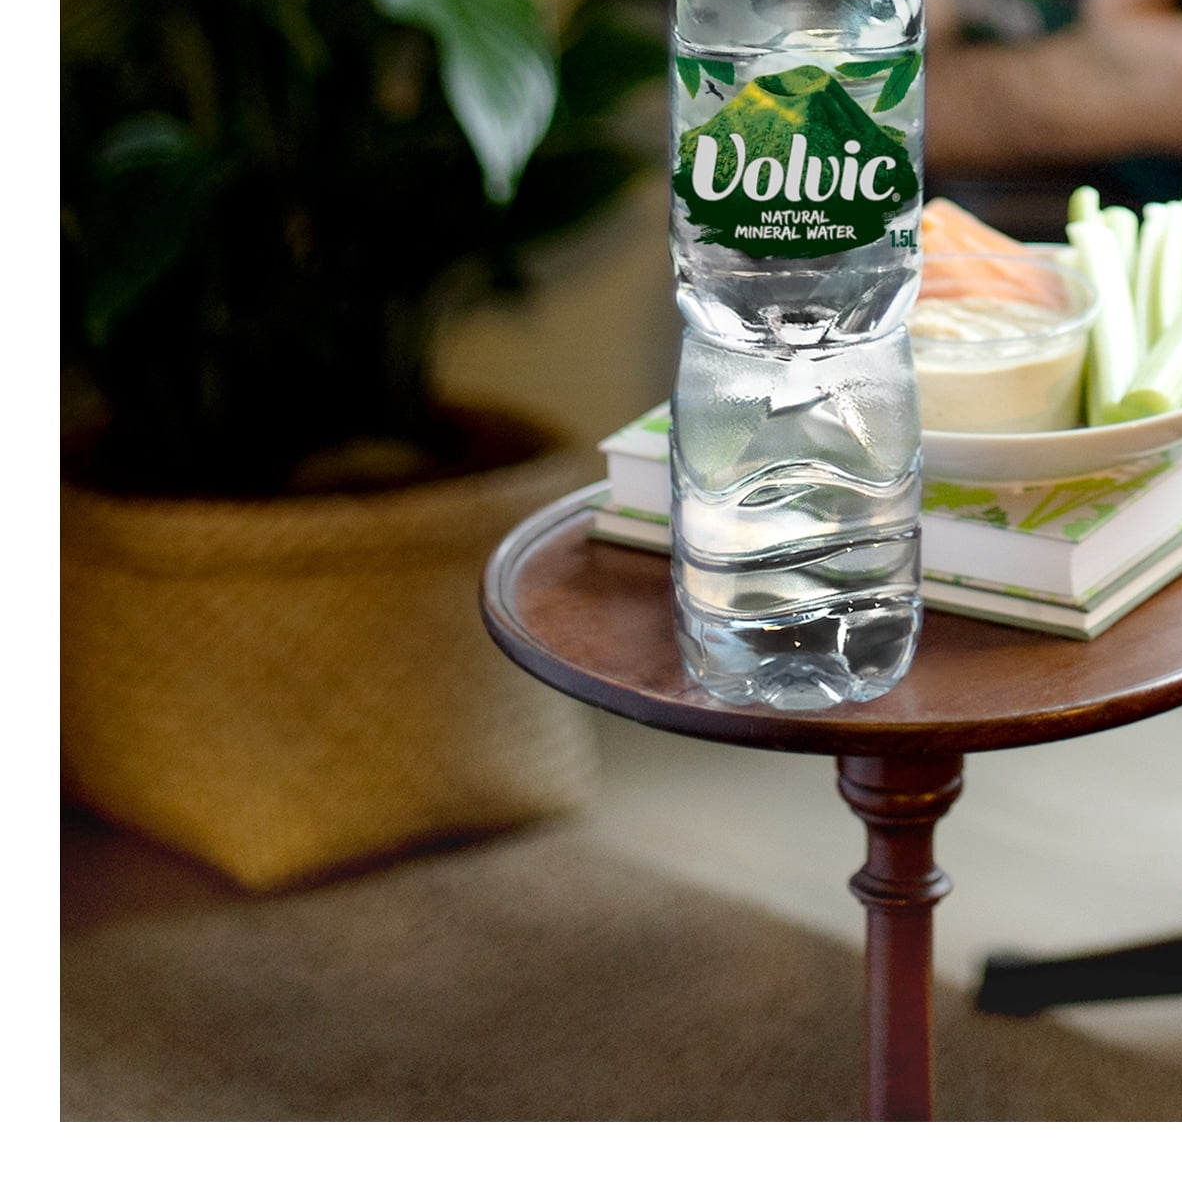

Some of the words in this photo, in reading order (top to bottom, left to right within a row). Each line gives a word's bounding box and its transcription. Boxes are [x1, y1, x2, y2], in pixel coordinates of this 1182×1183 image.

[691, 133, 897, 202] Volvic
[760, 209, 830, 226] NATURAL
[734, 224, 802, 241] MINERAL
[806, 224, 858, 241] WATER
[889, 229, 918, 248] 1.5L
